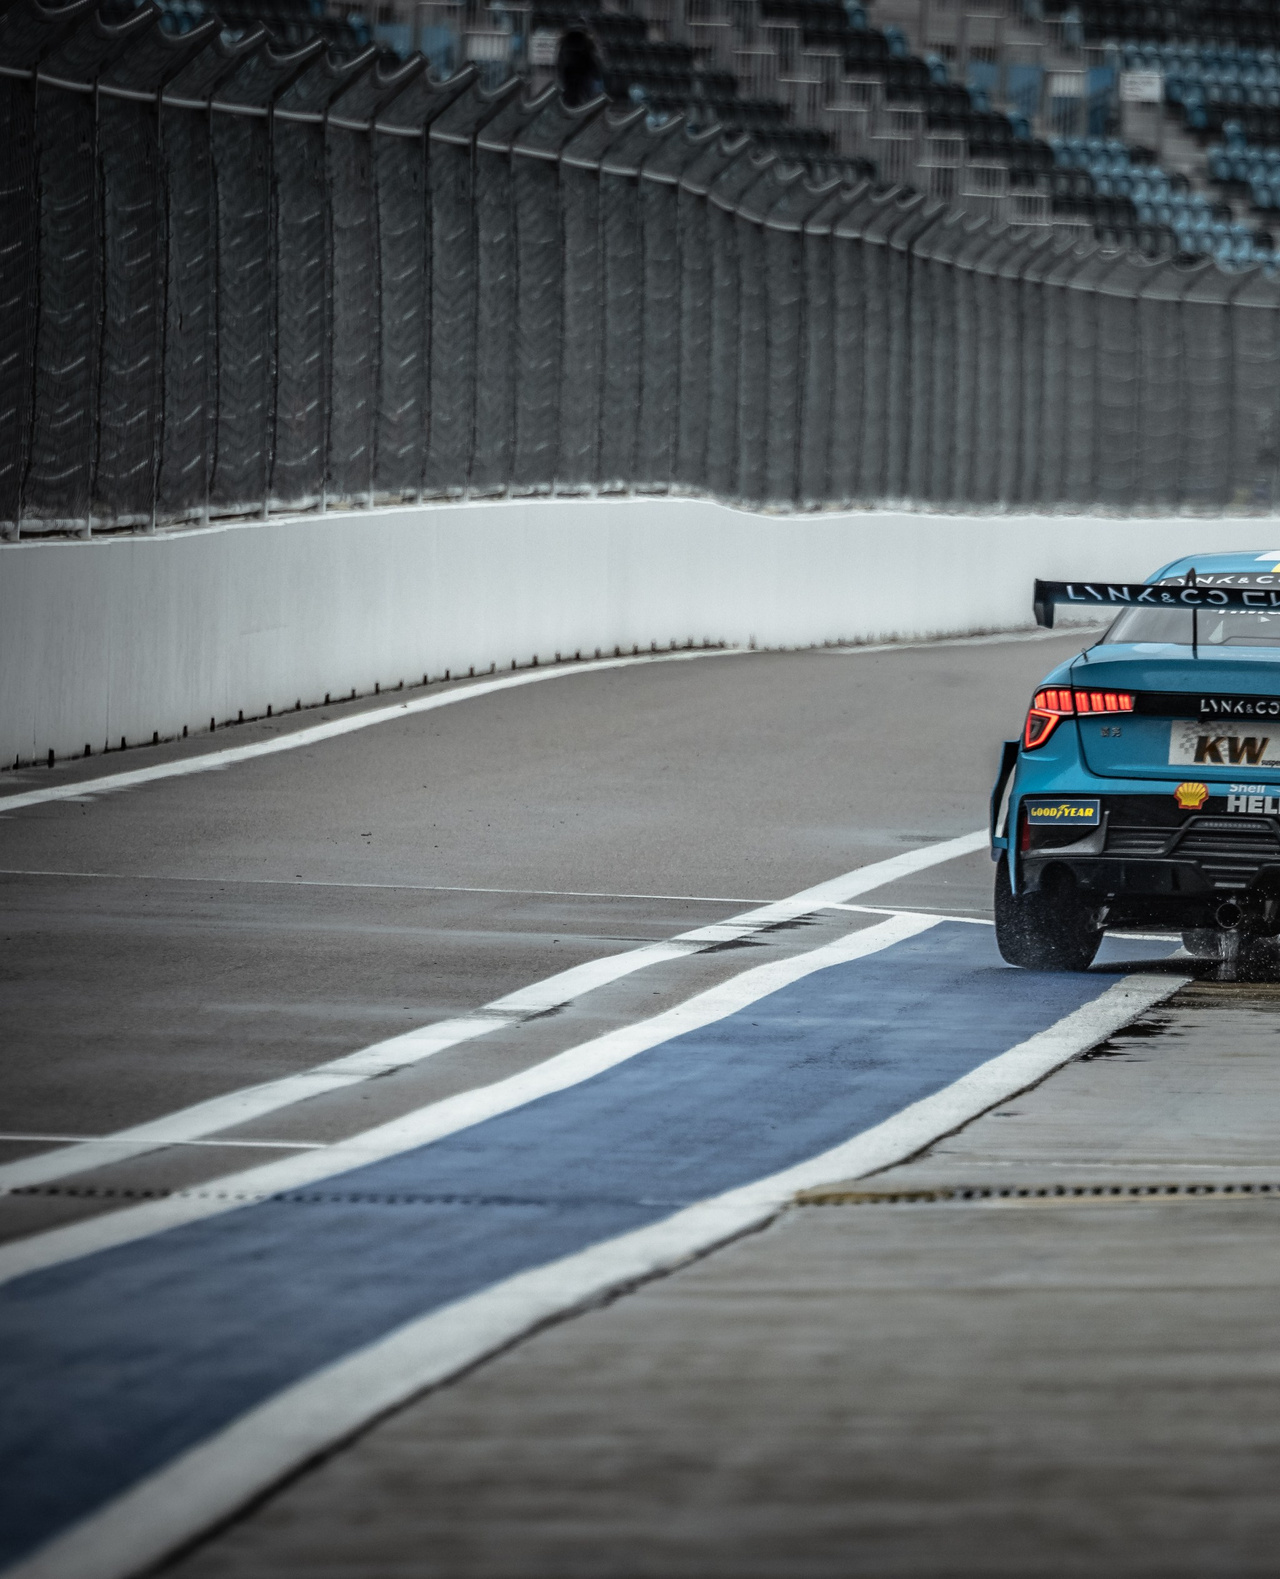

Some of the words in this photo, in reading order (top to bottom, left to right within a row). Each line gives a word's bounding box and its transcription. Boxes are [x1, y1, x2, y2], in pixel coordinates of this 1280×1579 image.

[1193, 736, 1270, 766] KW
[1229, 783, 1266, 794] Shell
[1031, 804, 1095, 819] GOODYEAR
